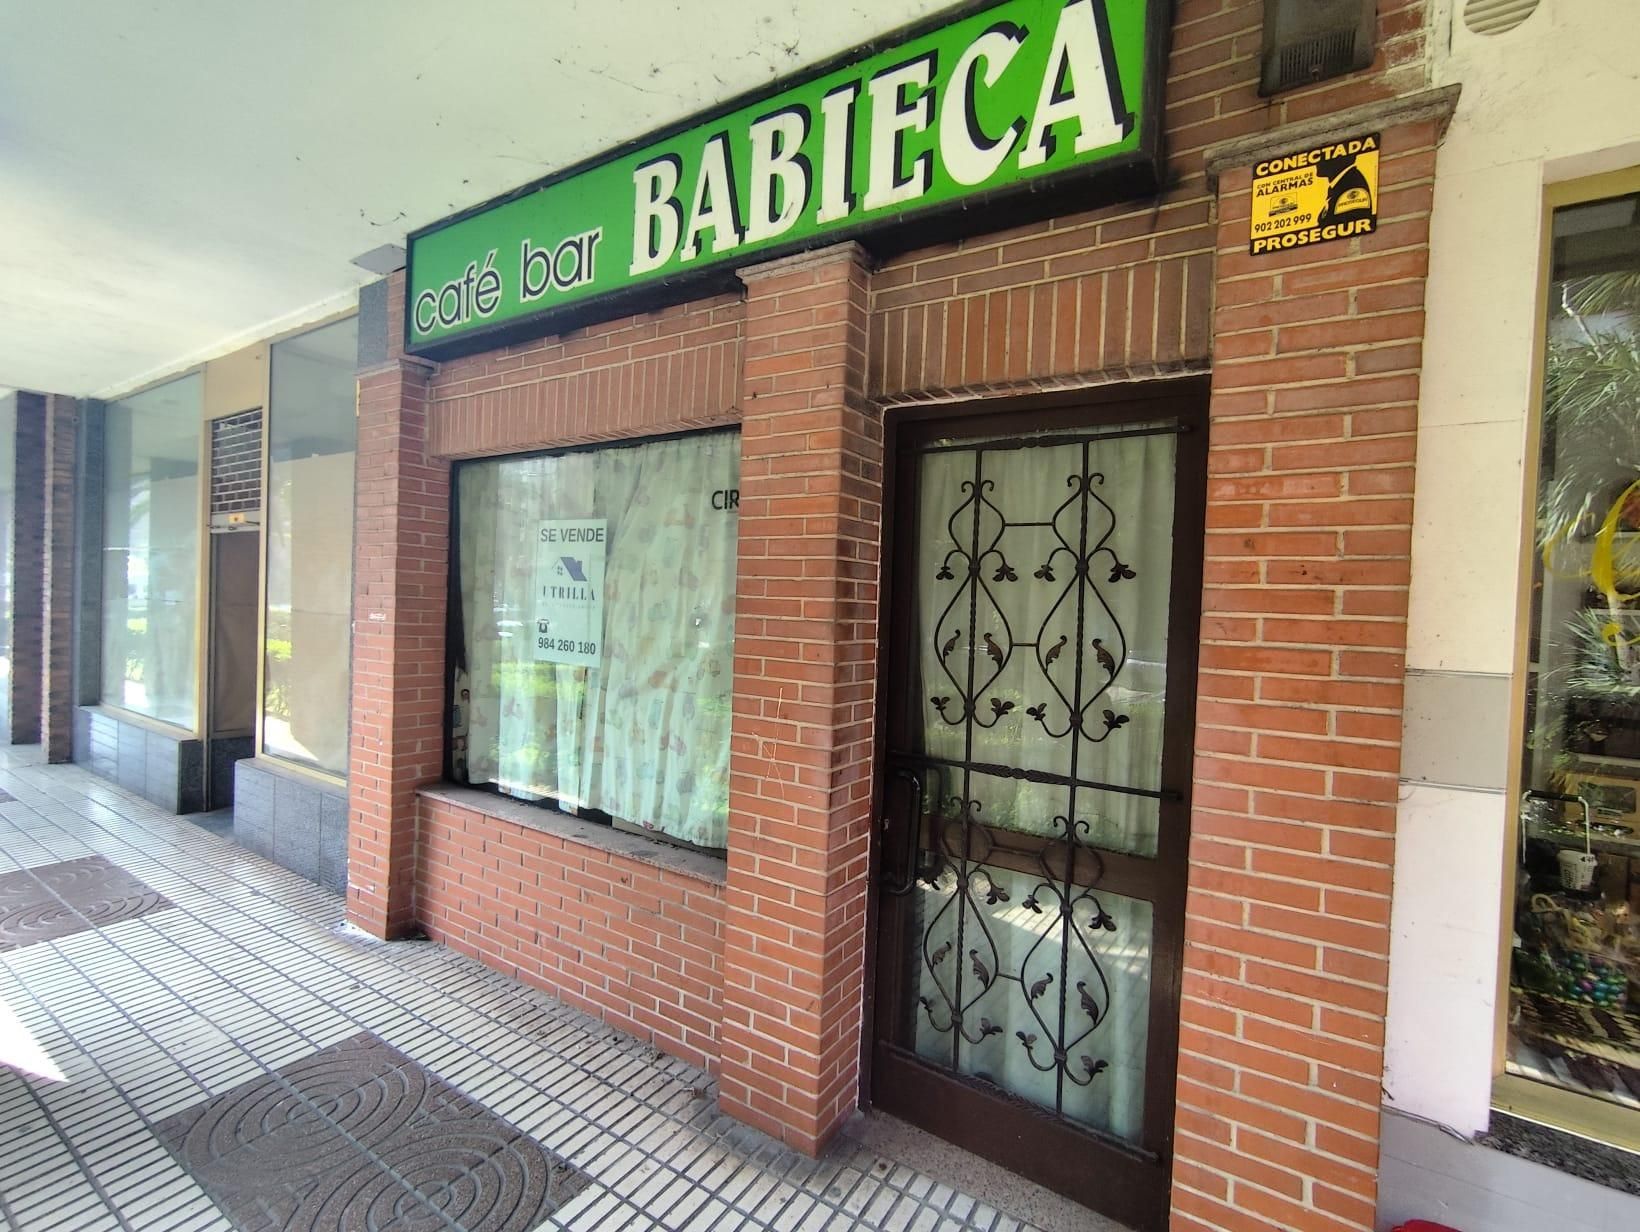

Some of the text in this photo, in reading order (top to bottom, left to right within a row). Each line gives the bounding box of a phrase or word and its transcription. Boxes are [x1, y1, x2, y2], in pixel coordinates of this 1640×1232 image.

[1255, 137, 1377, 177] CONECTADA
[414, 0, 1136, 335] café bar BABIECA
[1256, 177, 1314, 198] ALARMAS
[1272, 175, 1302, 186] CENTRAL
[1254, 213, 1312, 233] 902 202 999
[1253, 218, 1372, 254] PROSEGUR
[540, 527, 605, 543] SE VENDE
[538, 636, 596, 655] 984 260 180
